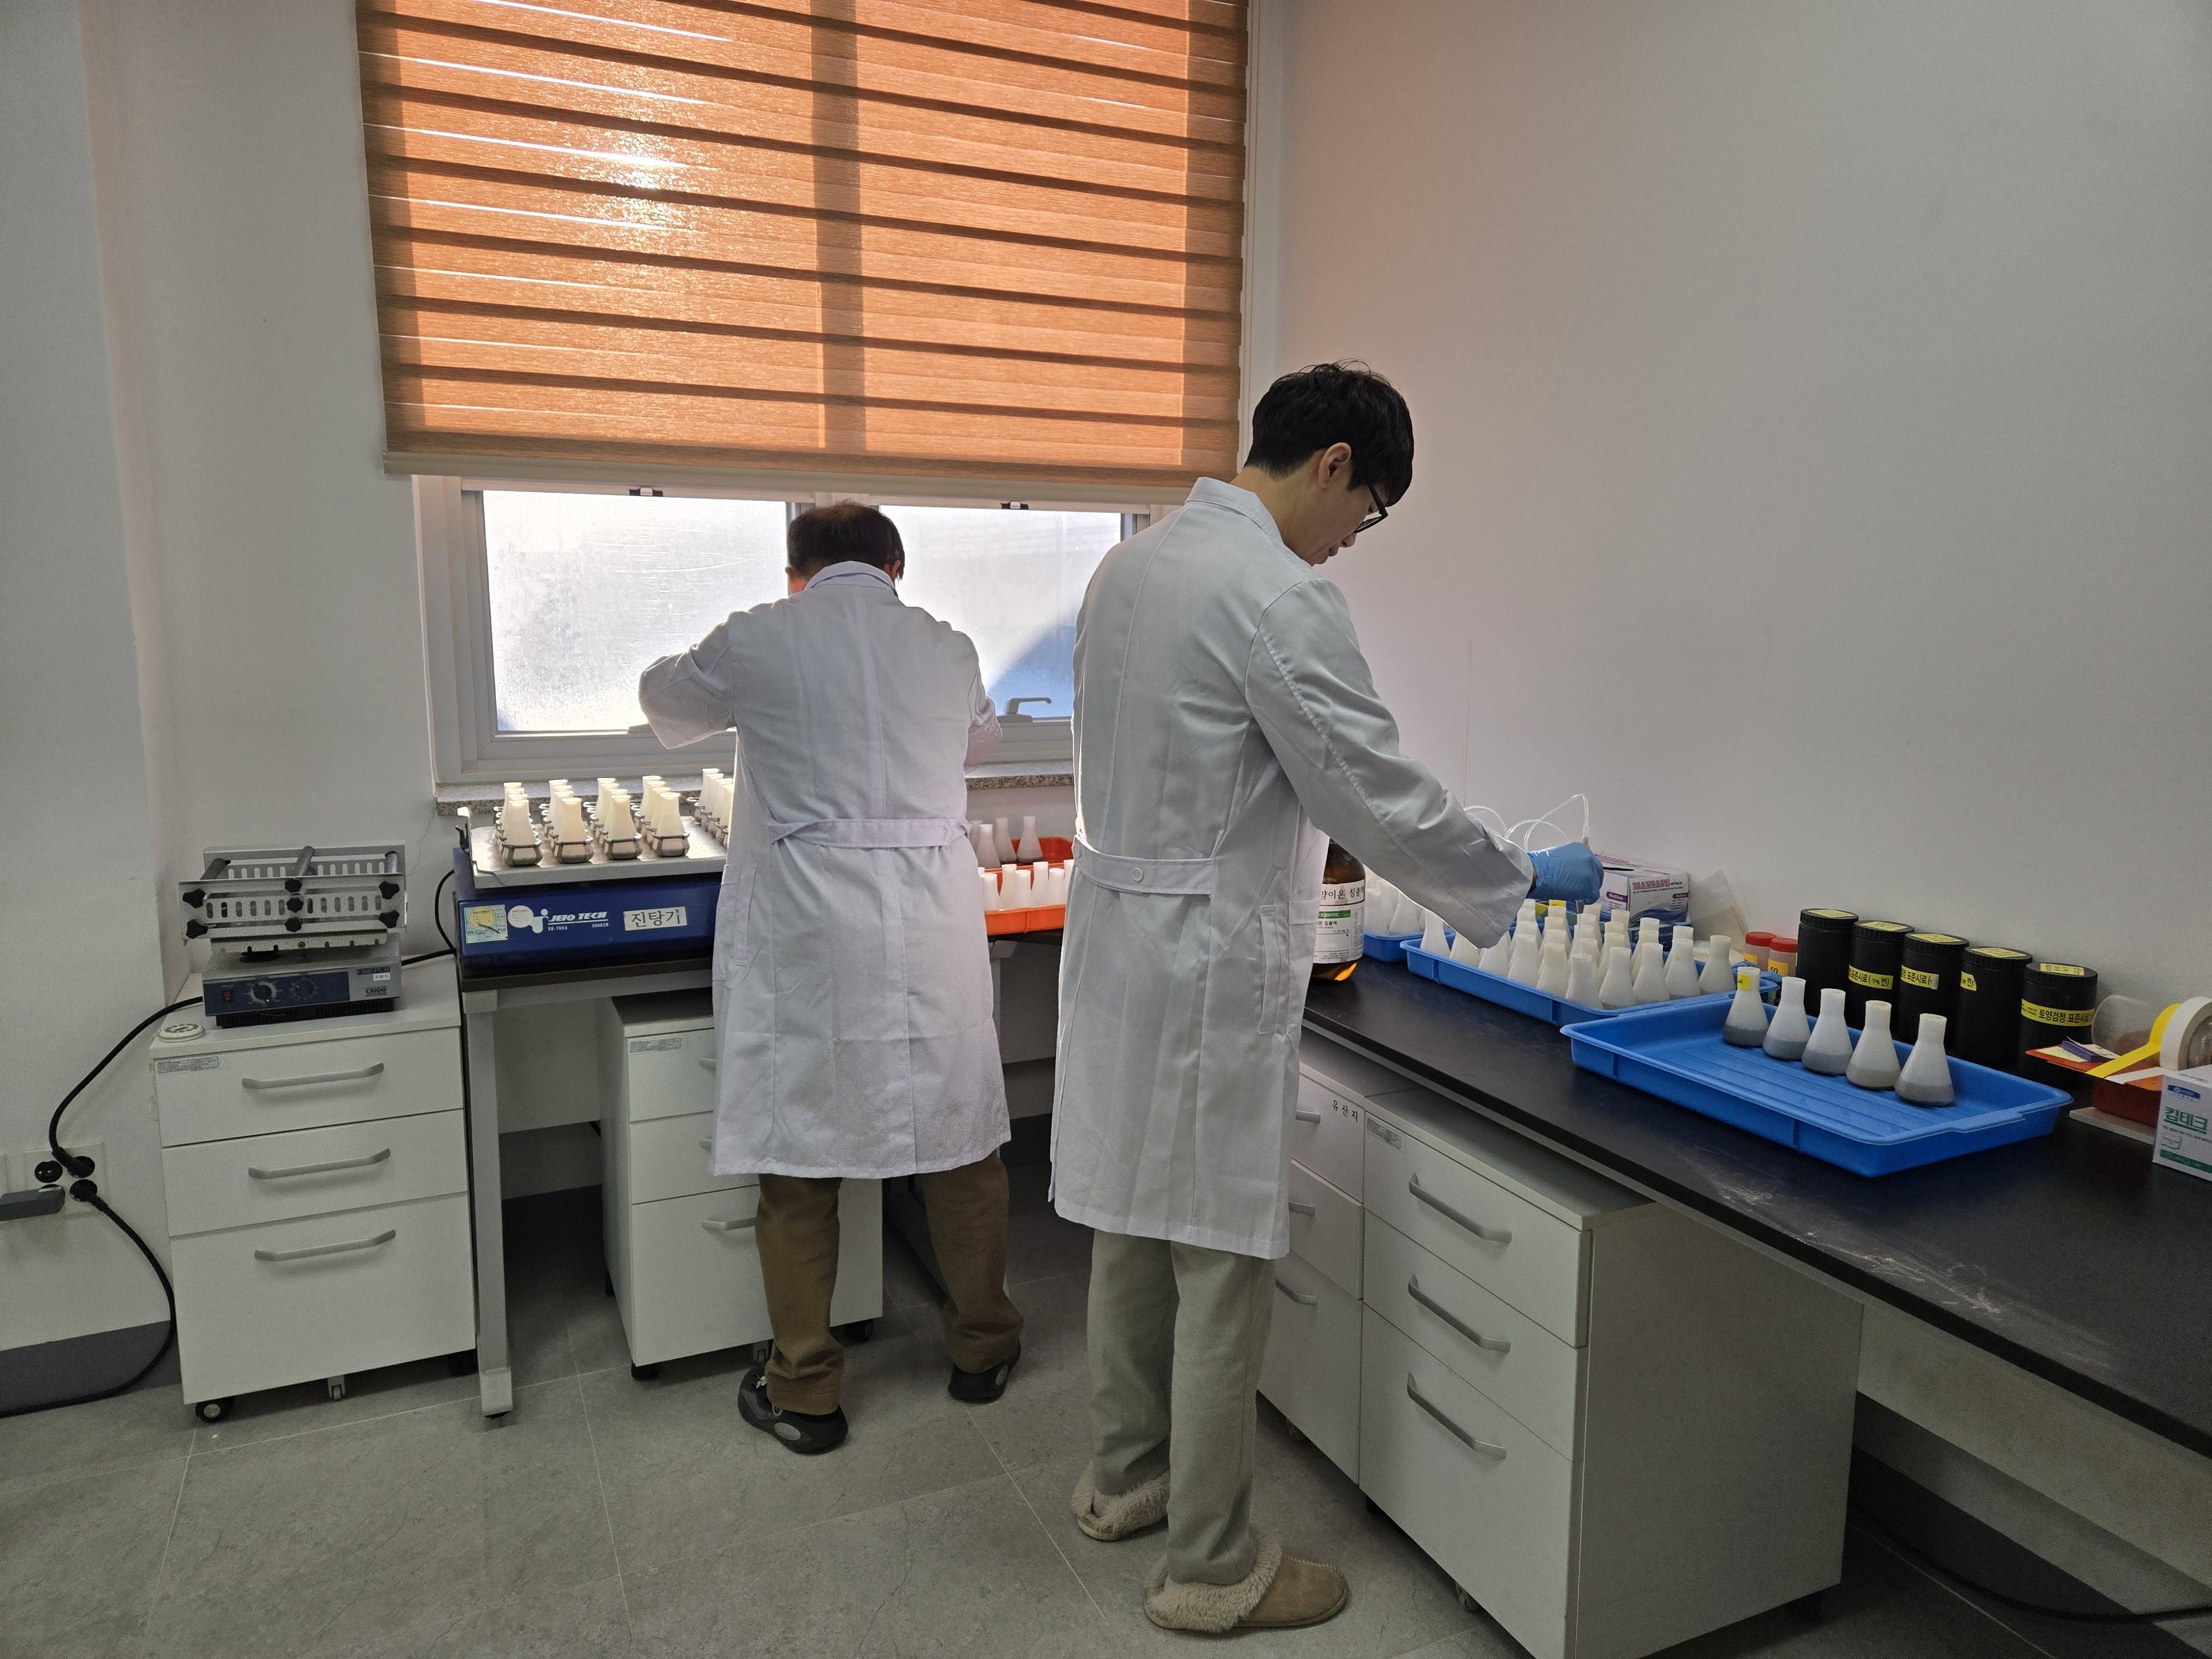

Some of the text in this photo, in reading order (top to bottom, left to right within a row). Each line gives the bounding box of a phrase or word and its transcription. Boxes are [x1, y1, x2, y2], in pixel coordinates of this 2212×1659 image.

[1320, 890, 1345, 900] 양이온
[578, 911, 607, 920] TECH
[631, 909, 680, 927] 진탕기
[1851, 970, 1867, 983] 표준시료
[1907, 971, 1927, 984] 표준시료
[2039, 1009, 2065, 1023] 토양검정
[1332, 1099, 1358, 1123] 유산지
[2165, 1106, 2208, 1131] 킴테크
